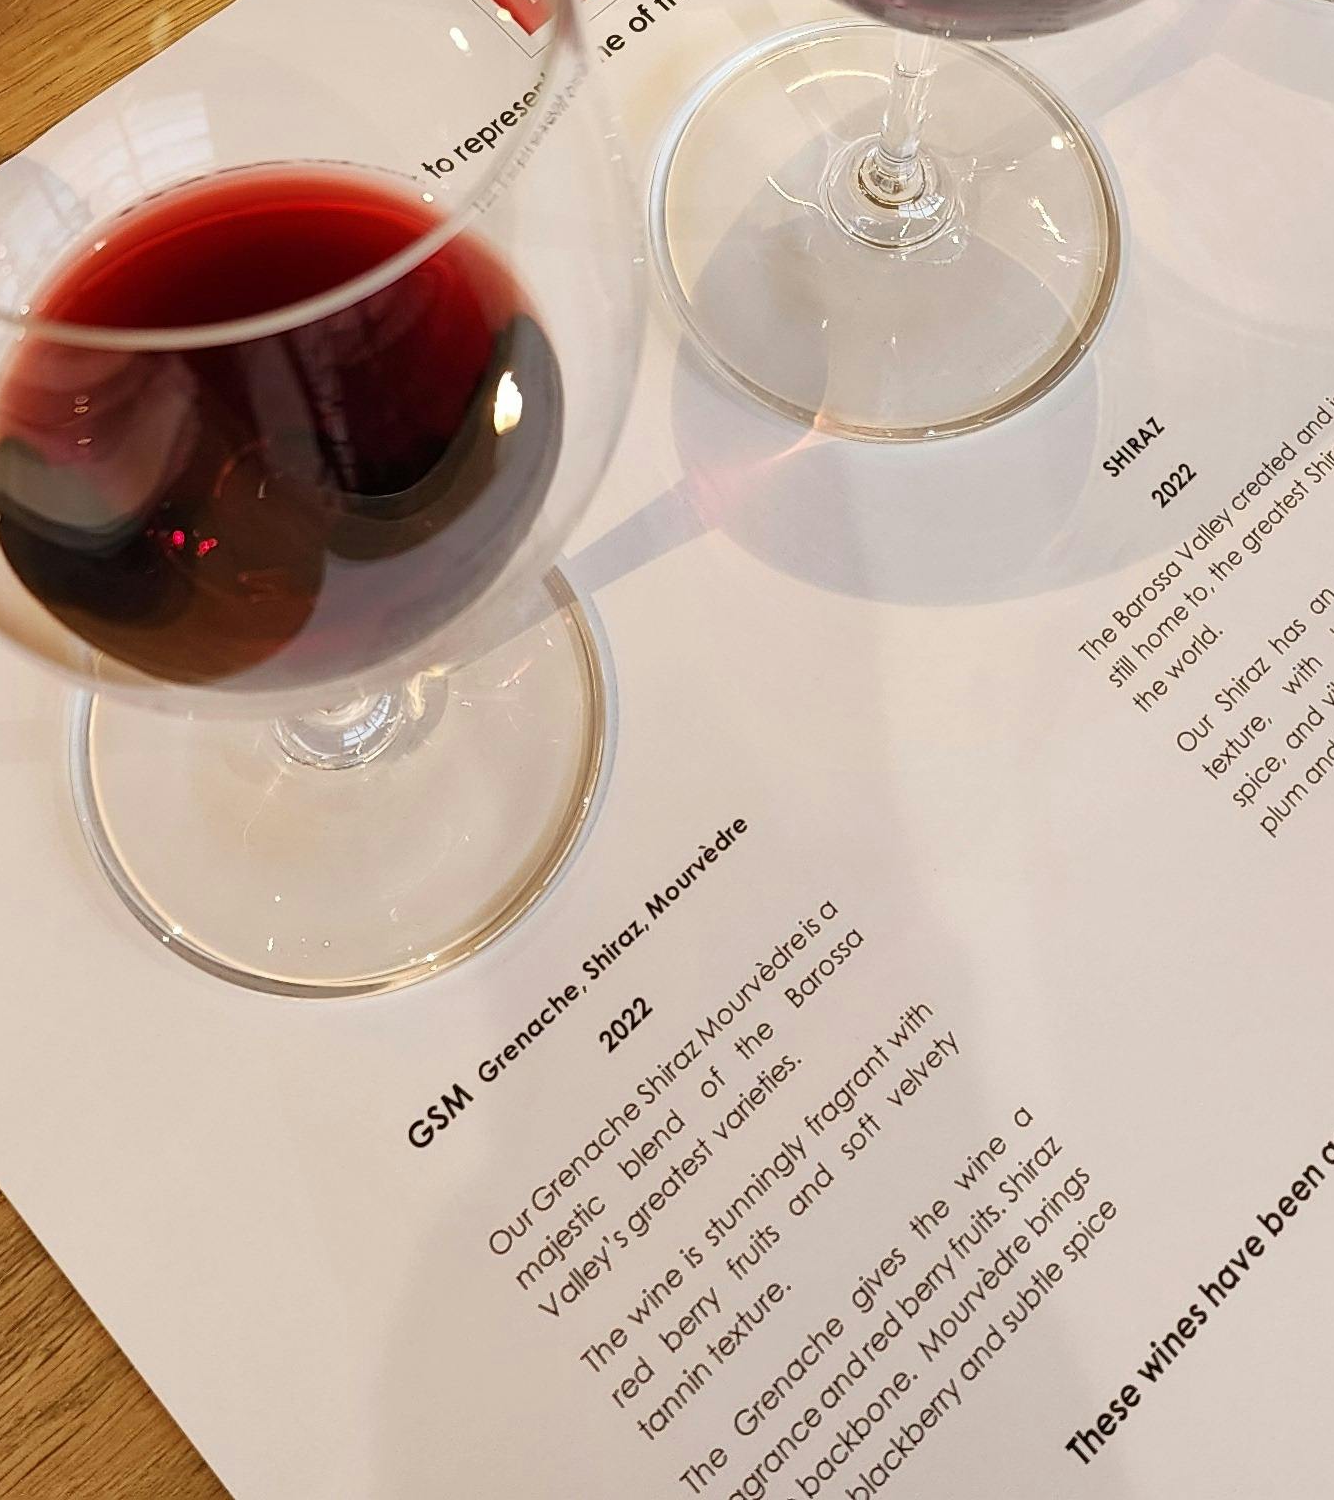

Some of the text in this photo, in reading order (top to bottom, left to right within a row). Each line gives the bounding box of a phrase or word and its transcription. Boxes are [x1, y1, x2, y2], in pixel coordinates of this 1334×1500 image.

[627, 2, 656, 33] of
[419, 156, 455, 180] to
[1101, 415, 1165, 478] SHIRAZ
[1150, 462, 1198, 509] 2022
[1076, 627, 1118, 661] The
[1111, 560, 1183, 629] Barossa
[1173, 507, 1234, 561] Valley
[1230, 440, 1298, 511] created
[1295, 404, 1334, 445] and
[407, 817, 748, 1148] GSM Grenache, Shiraz, Mourvèdre
[598, 996, 653, 1054] 2022
[488, 899, 839, 1255] Our Grenache Shiraz Mourvèdre is a
[1063, 1383, 1141, 1465] These
[1136, 1302, 1208, 1383] wines
[1196, 1234, 1265, 1308] have
[1255, 1163, 1326, 1238] been
